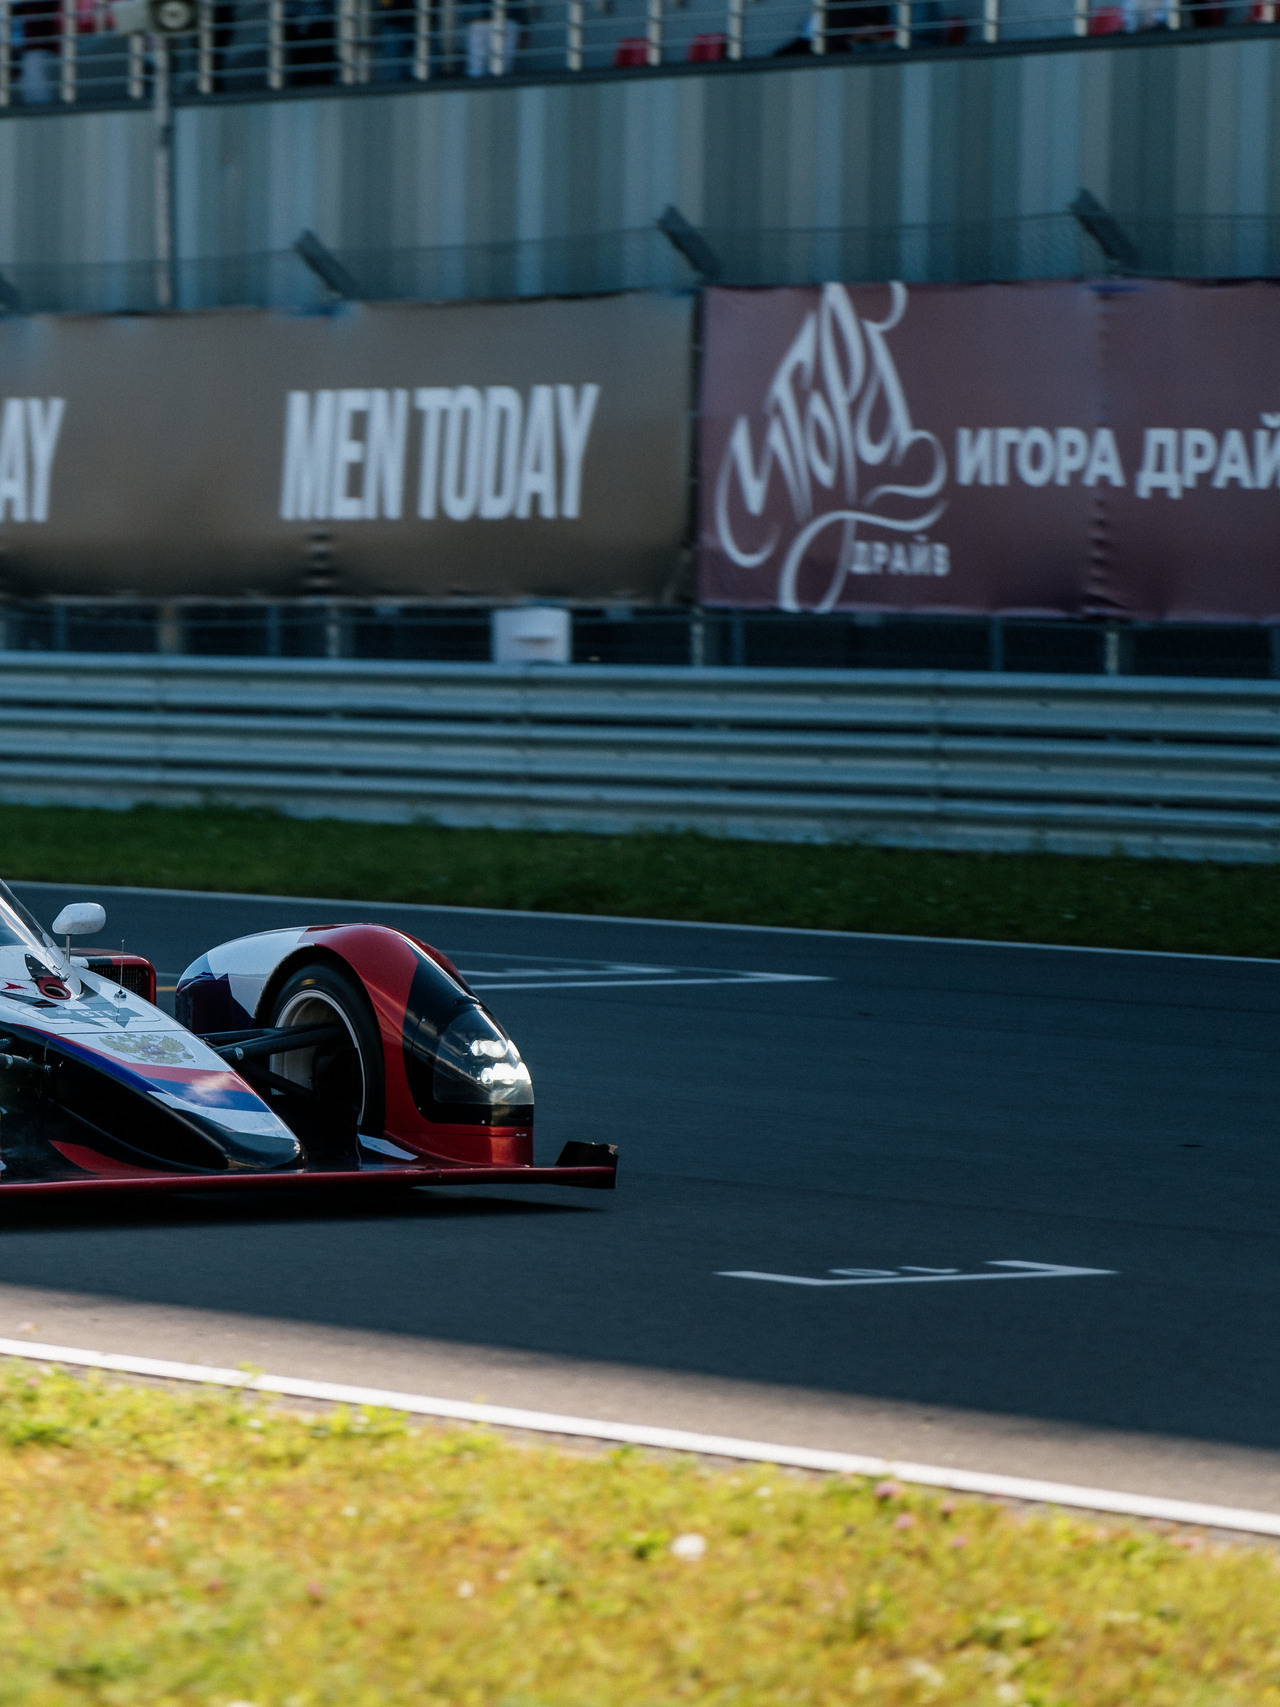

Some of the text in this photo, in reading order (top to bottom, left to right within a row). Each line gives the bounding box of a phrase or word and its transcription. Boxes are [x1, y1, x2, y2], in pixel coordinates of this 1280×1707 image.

[281, 383, 600, 521] MEN TODAY
[956, 412, 1280, 499] ИГОРА ДРАЙ
[849, 534, 951, 577] ДРАЙВ
